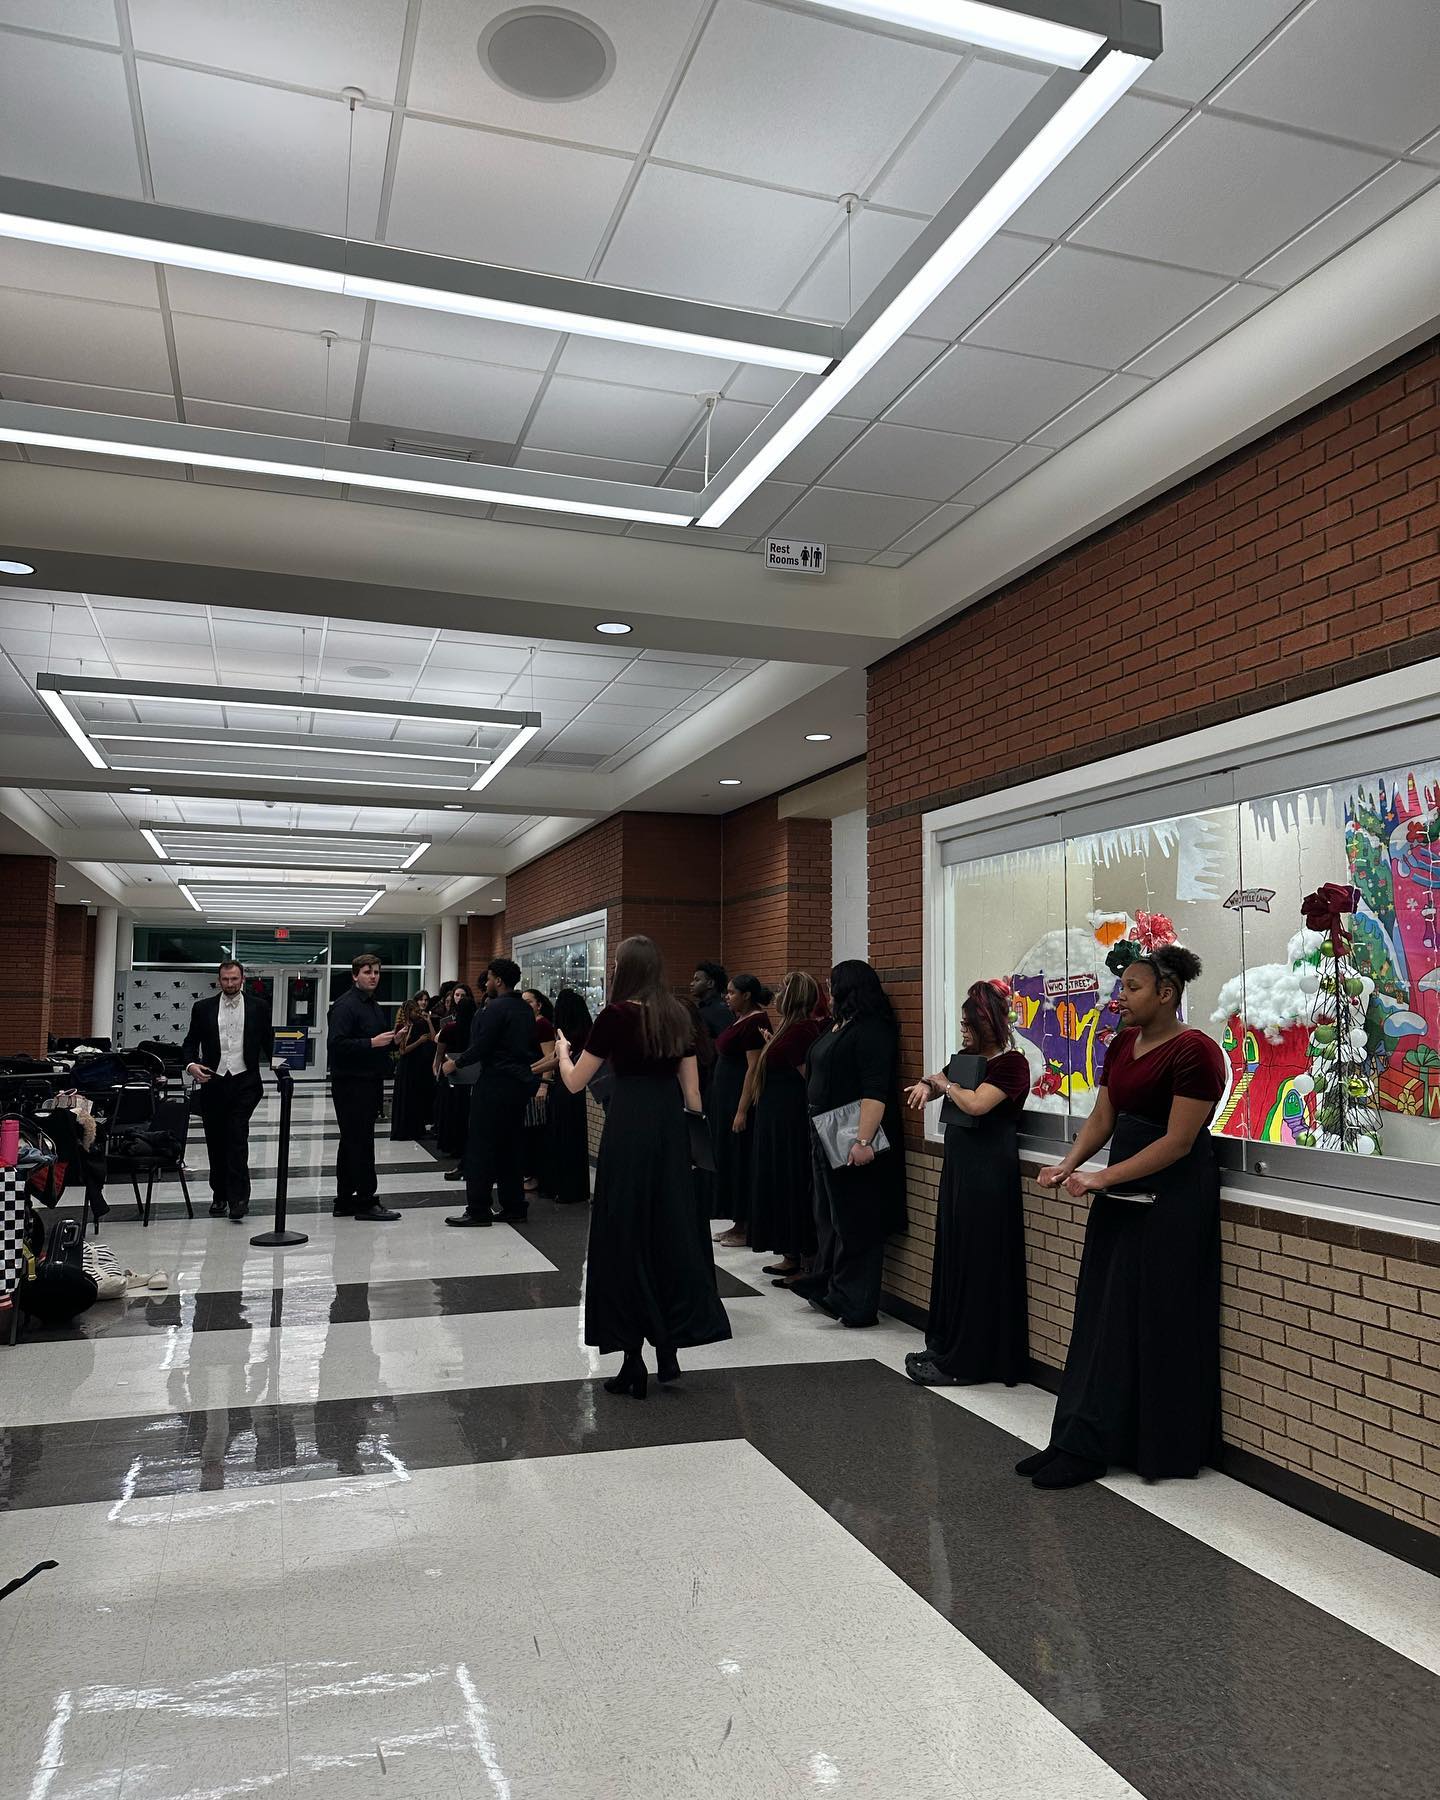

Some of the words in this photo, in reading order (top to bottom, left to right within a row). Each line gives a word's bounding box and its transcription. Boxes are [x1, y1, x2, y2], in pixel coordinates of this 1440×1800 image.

[770, 543, 790, 554] Rest
[769, 554, 799, 565] Rooms
[1049, 982, 1063, 991] WHO
[1065, 978, 1091, 989] STREET
